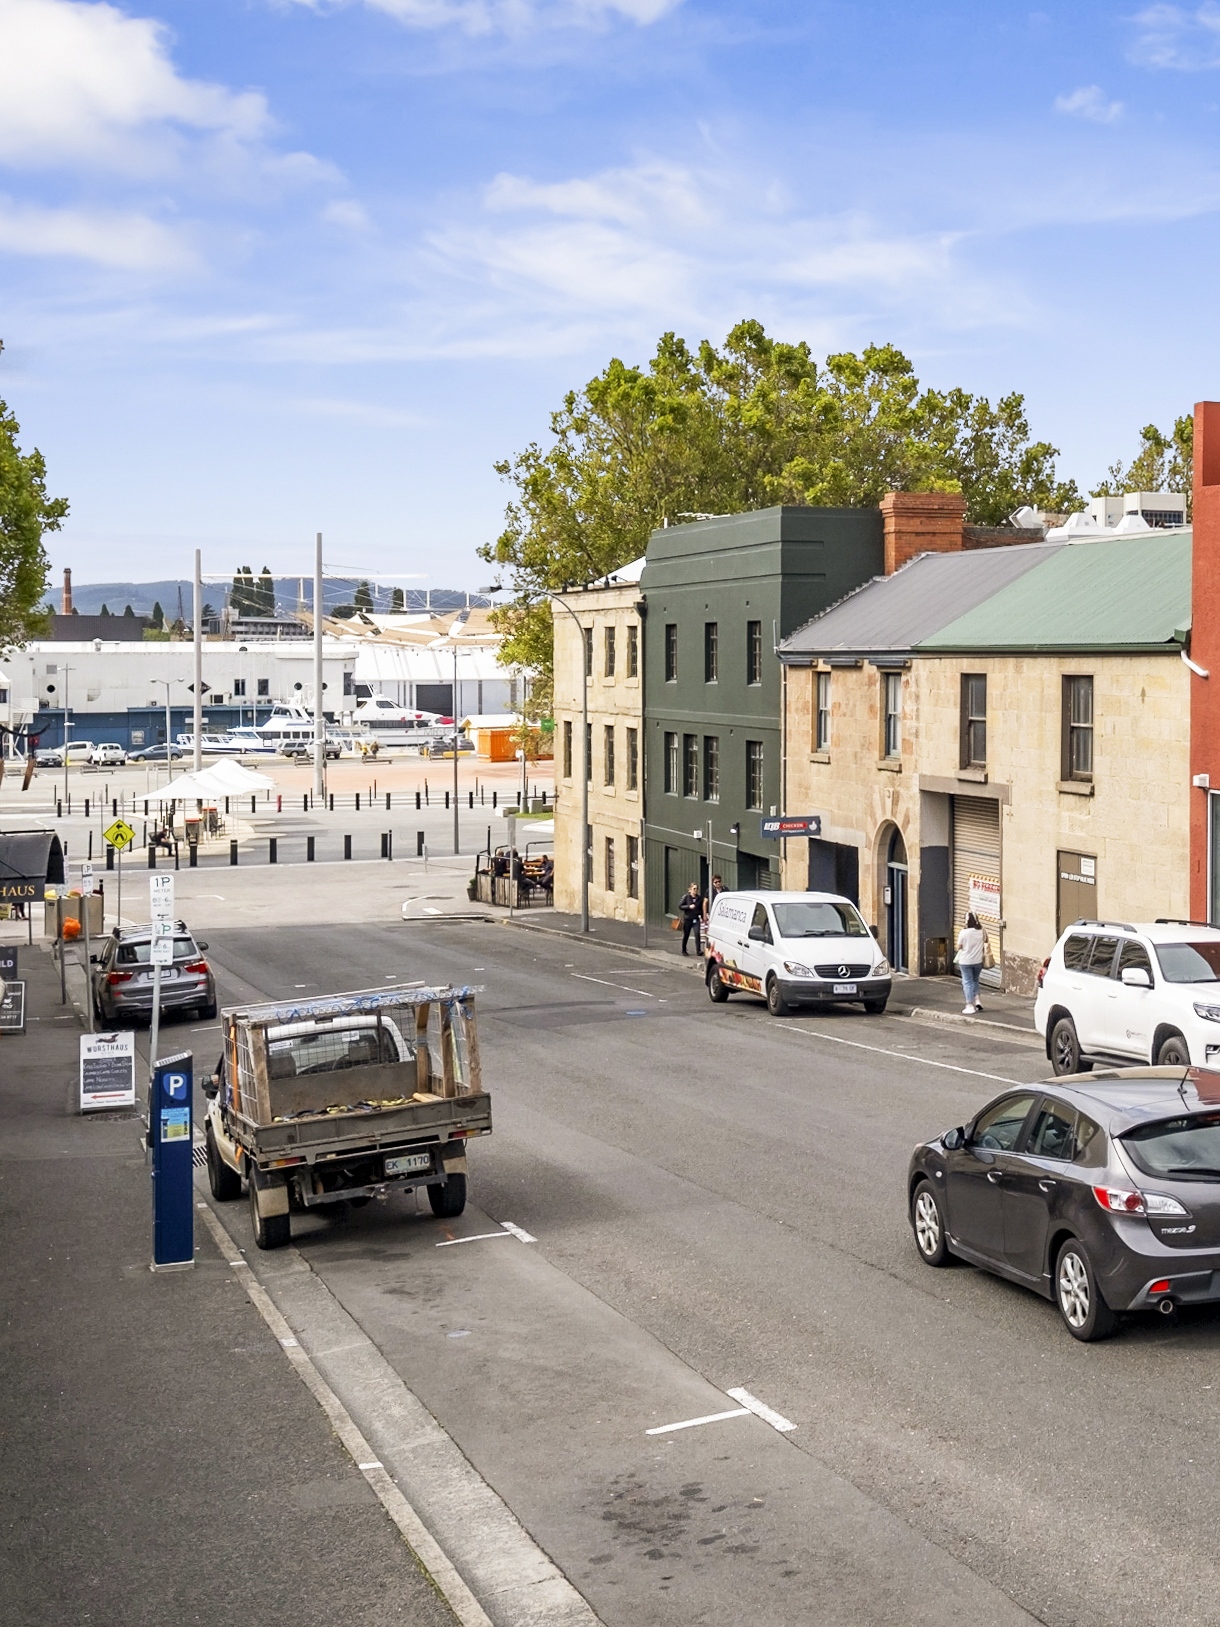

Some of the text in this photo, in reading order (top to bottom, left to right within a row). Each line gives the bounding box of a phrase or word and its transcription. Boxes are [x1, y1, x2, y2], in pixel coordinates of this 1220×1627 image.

[155, 876, 170, 887] 1P
[718, 901, 746, 923] Salamanca
[169, 1075, 184, 1096] P
[407, 1155, 429, 1167] 1170
